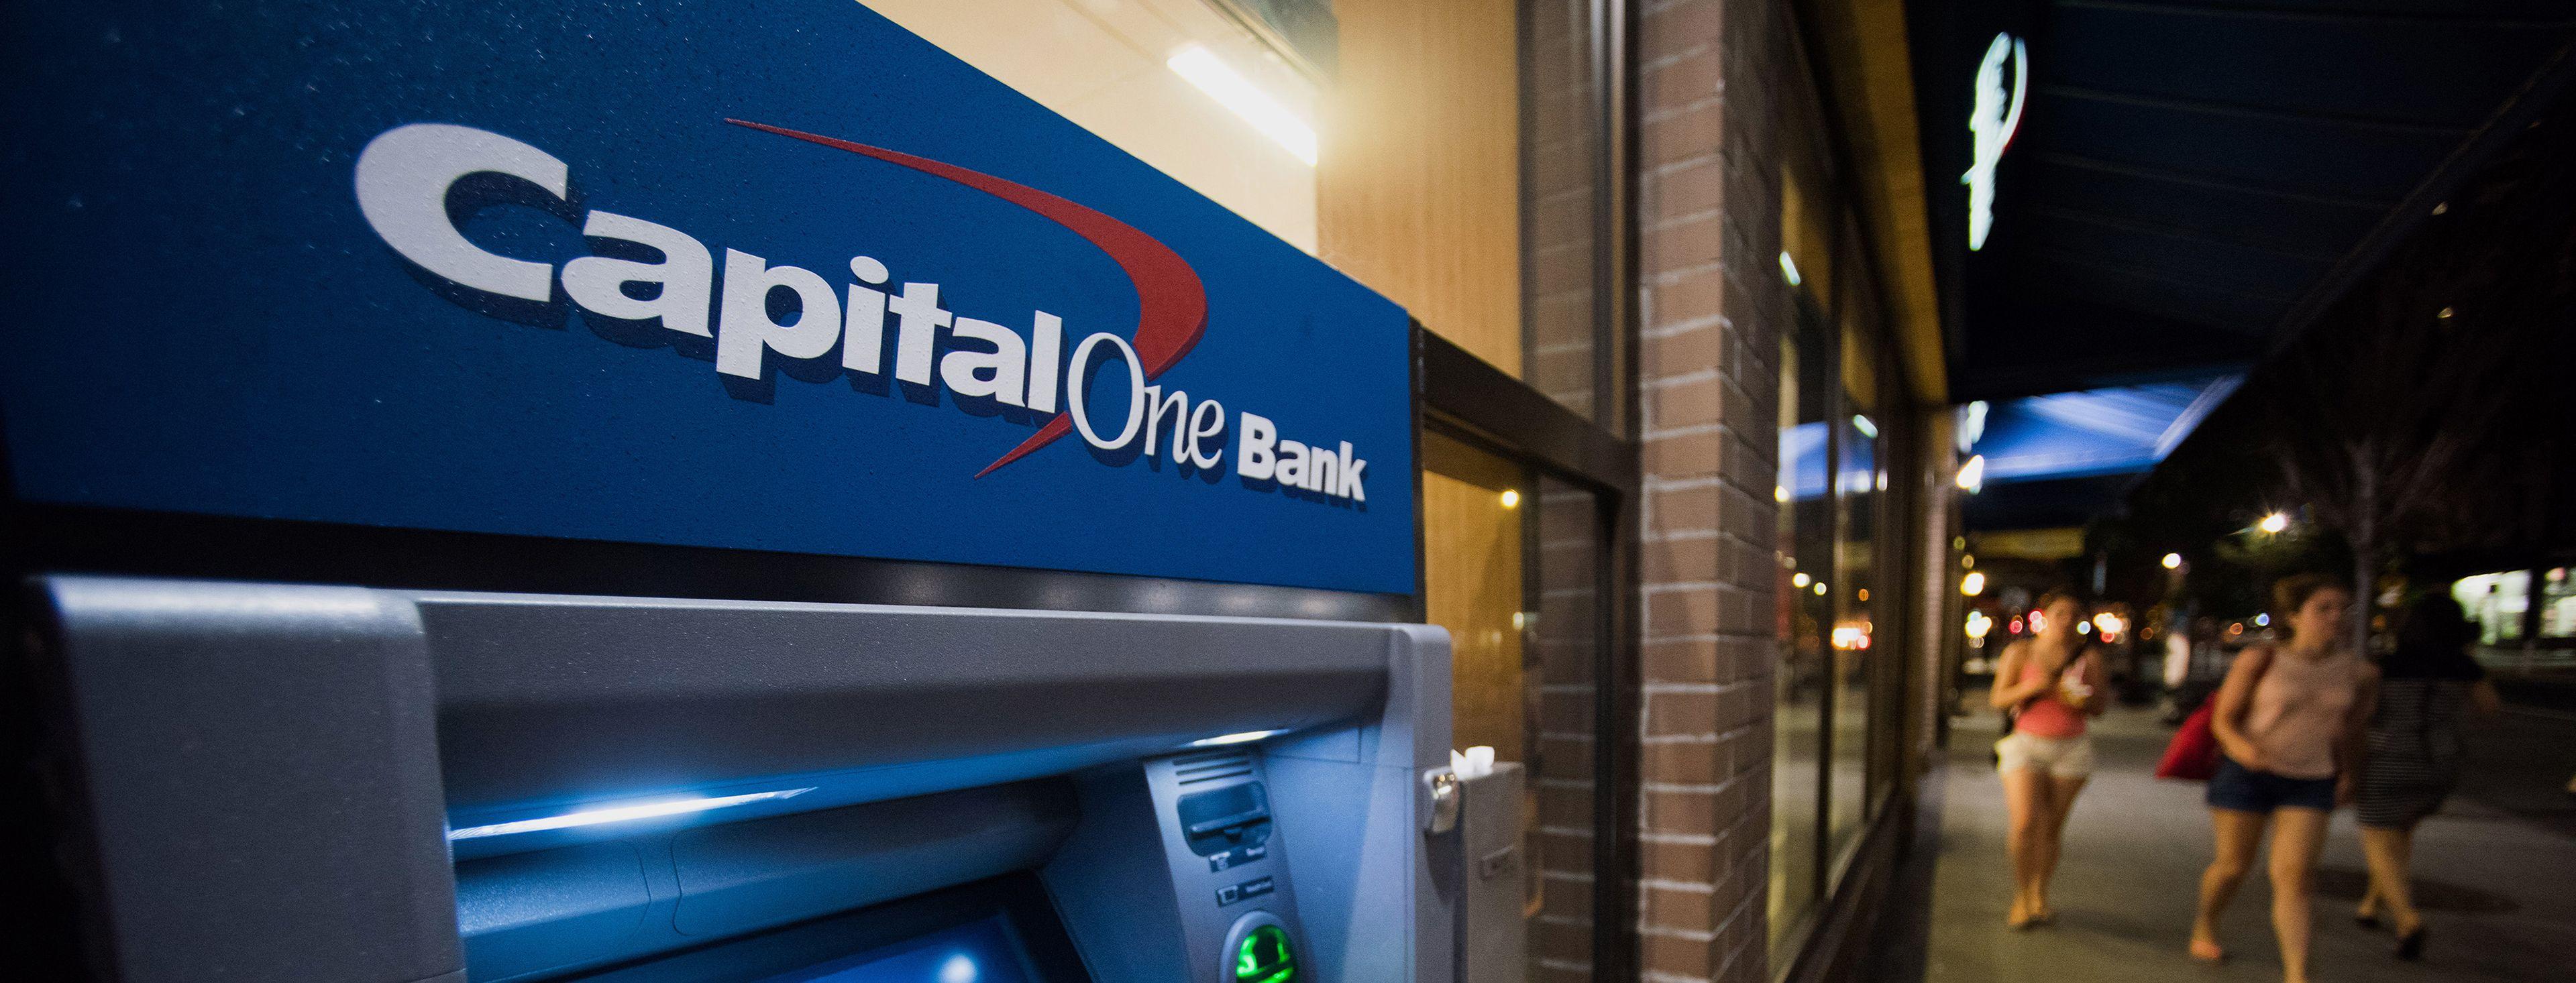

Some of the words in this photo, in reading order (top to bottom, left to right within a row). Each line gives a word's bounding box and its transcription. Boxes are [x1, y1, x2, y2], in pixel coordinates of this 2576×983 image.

[354, 123, 1062, 414] Capital
[1067, 332, 1226, 469] One
[1236, 411, 1367, 502] Bank
